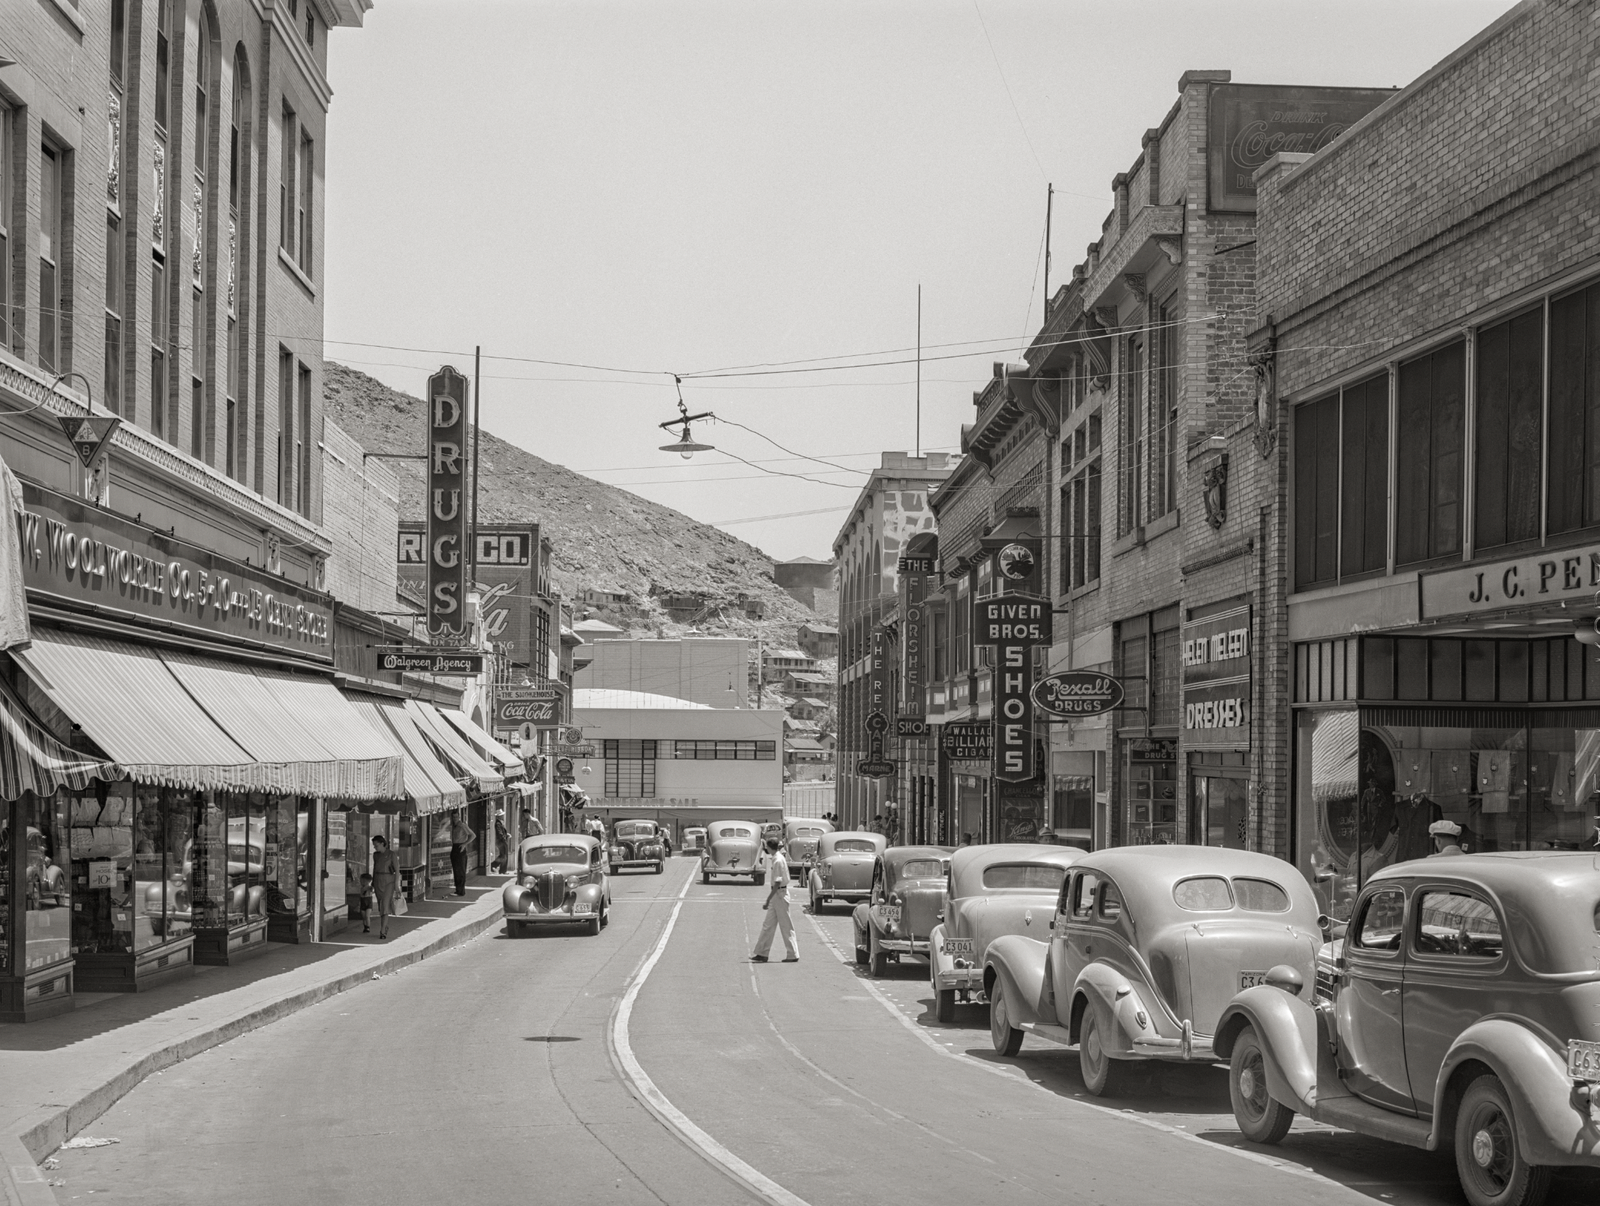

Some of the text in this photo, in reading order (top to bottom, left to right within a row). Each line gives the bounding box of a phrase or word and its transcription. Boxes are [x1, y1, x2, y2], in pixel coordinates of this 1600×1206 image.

[1270, 111, 1328, 124] DRINK
[1236, 173, 1258, 189] DE
[433, 394, 461, 615] DRUGS
[399, 533, 528, 564] R CO.
[907, 559, 928, 572] THE
[46, 517, 166, 595] WOOLWORTH
[248, 587, 263, 621] 15
[264, 593, 295, 631] CENT
[295, 604, 328, 639] STORE
[1469, 572, 1490, 603] J.
[1502, 565, 1525, 599] C.
[988, 604, 1041, 620] GIVEN
[989, 624, 1044, 639] BROS.
[447, 639, 466, 647] TAP
[906, 577, 921, 715] FLORSHEIM
[384, 654, 471, 672] Walgreen Agency
[1045, 678, 1112, 701] Rexall
[500, 701, 555, 720] Coca-Cola
[1003, 646, 1025, 772] SHOES
[1054, 700, 1102, 711] DRUGS
[1186, 697, 1243, 729] DRESSES
[872, 717, 882, 763] CAFE
[590, 797, 699, 807] ANNIVERSARY SALE
[879, 907, 887, 915] C3
[946, 942, 972, 951] C3 041
[1241, 976, 1255, 989] C3
